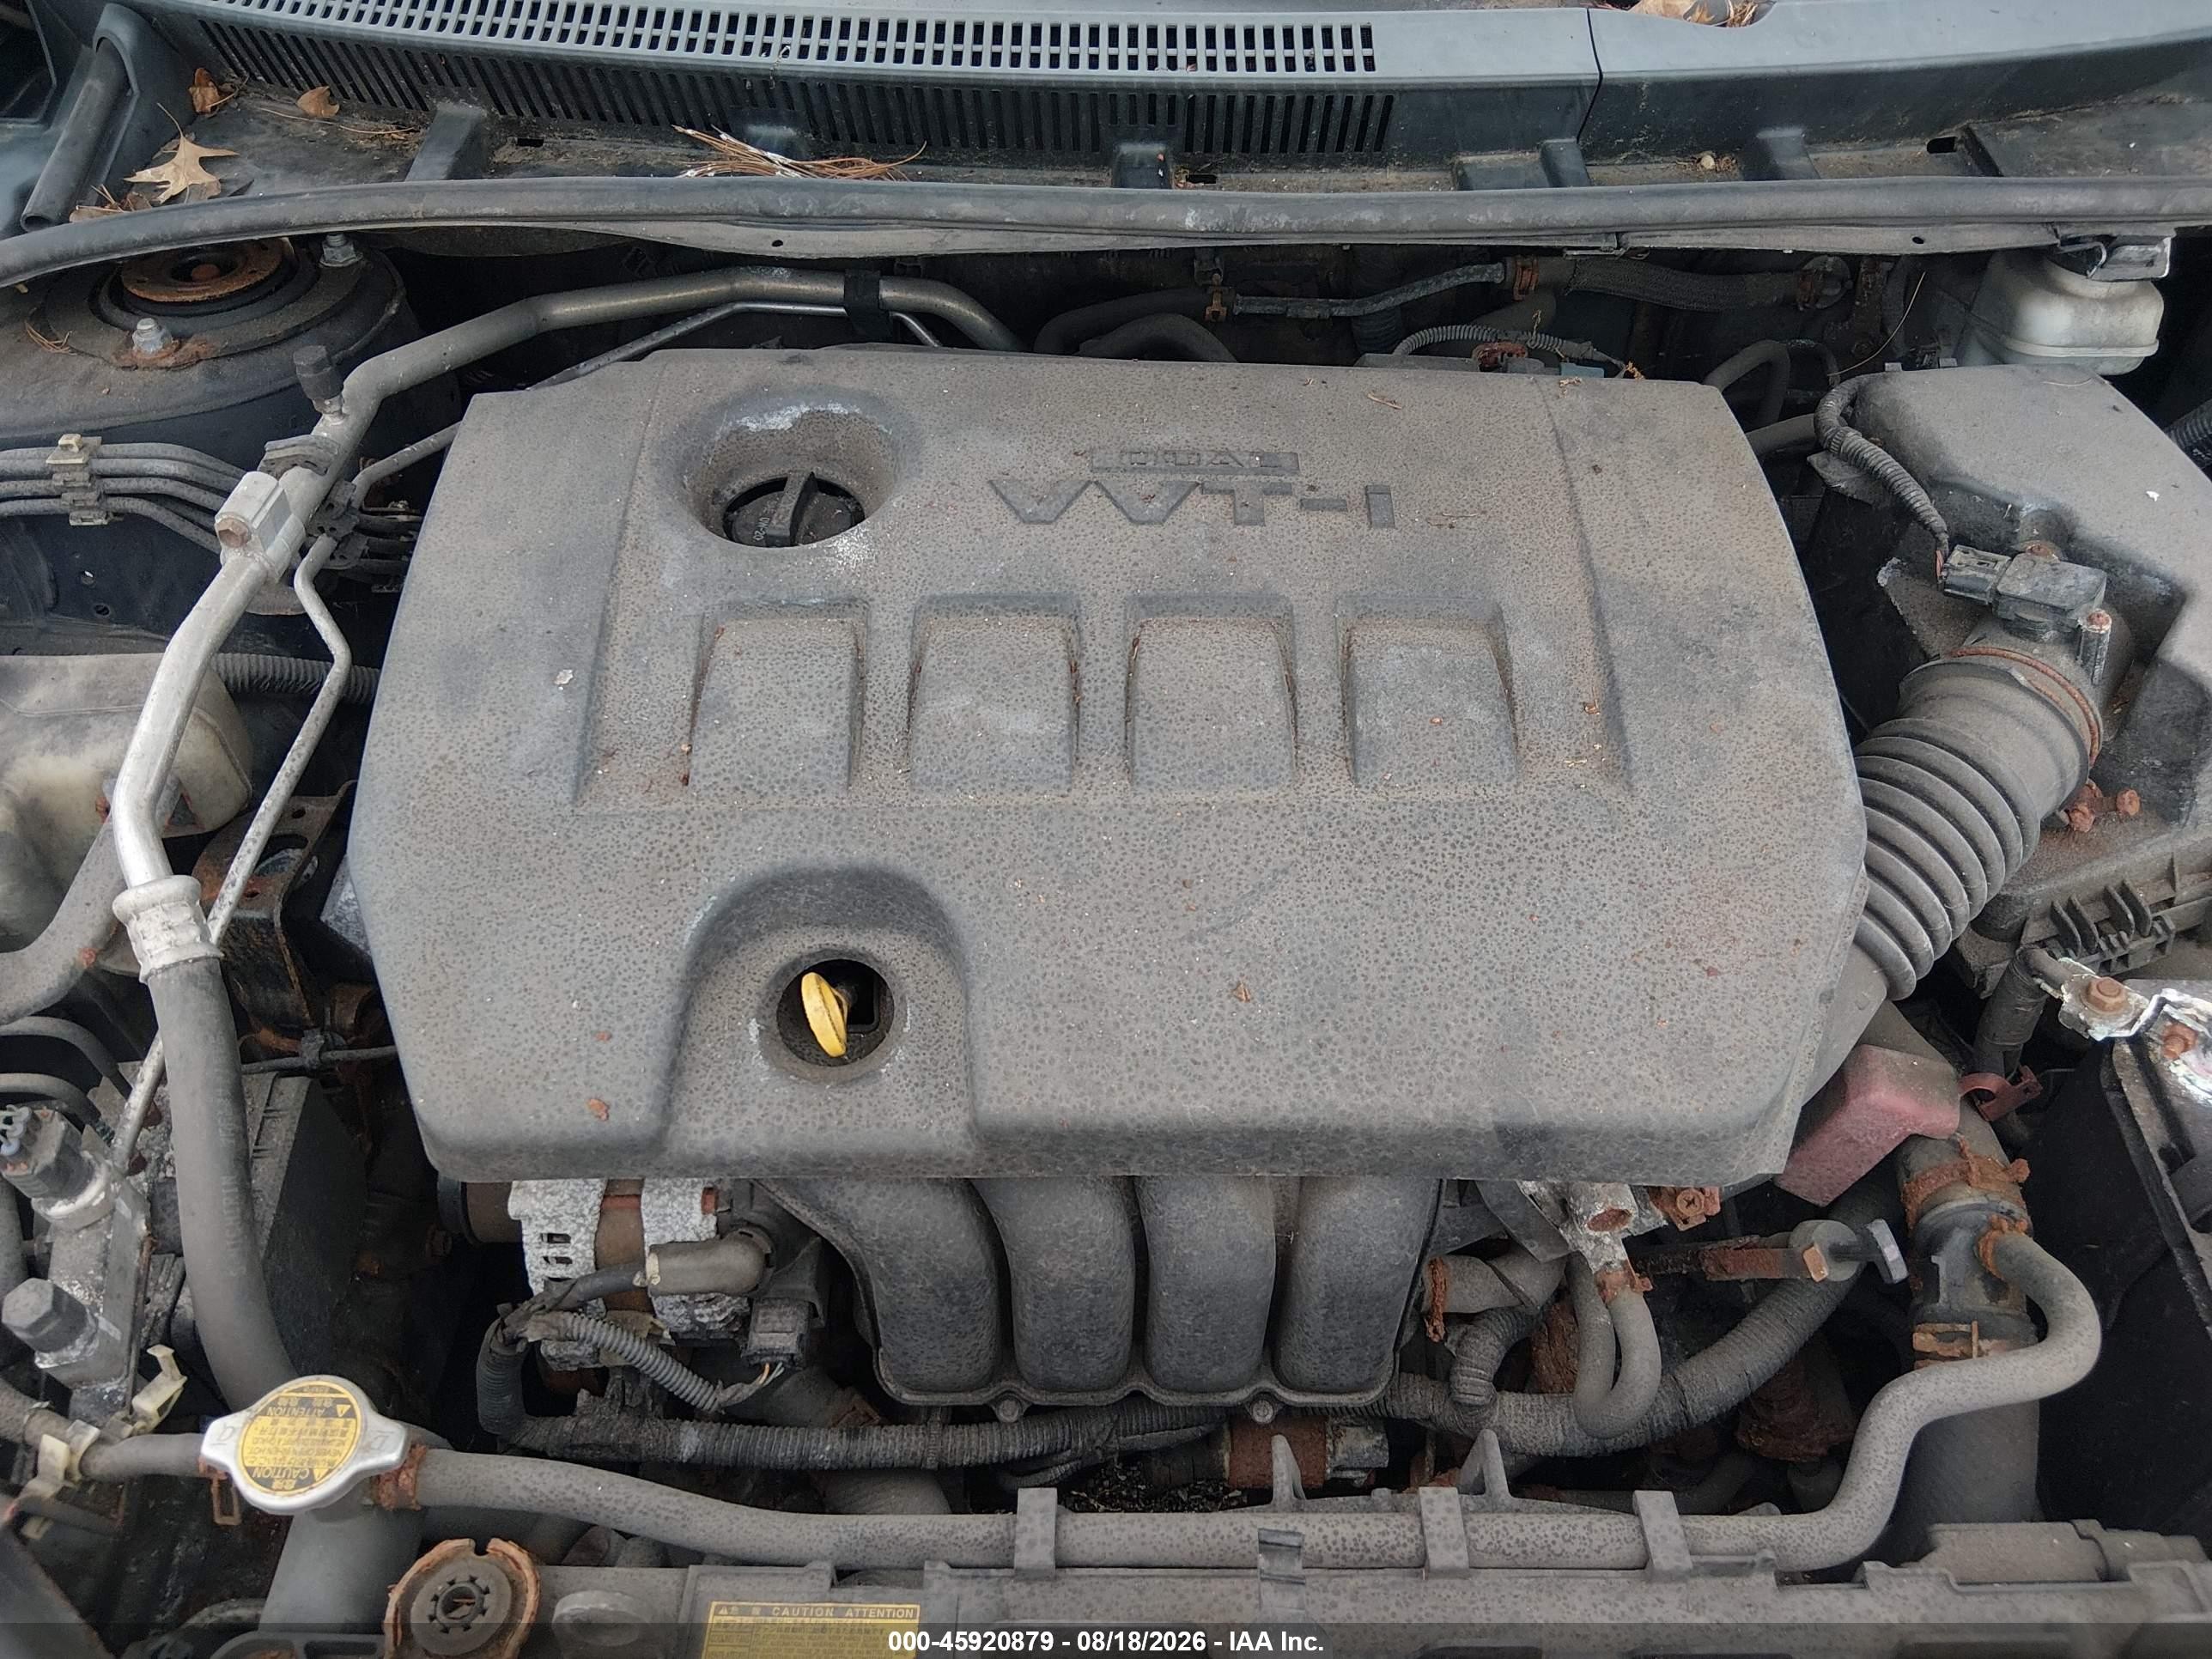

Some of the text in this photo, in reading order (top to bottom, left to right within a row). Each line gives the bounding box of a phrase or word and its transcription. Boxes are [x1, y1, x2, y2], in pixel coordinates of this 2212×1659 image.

[266, 1406, 325, 1417] ATTENTION
[252, 1467, 310, 1479] CAUTION
[773, 1606, 834, 1617] CAUTION
[845, 1607, 915, 1619] ATTENTION
